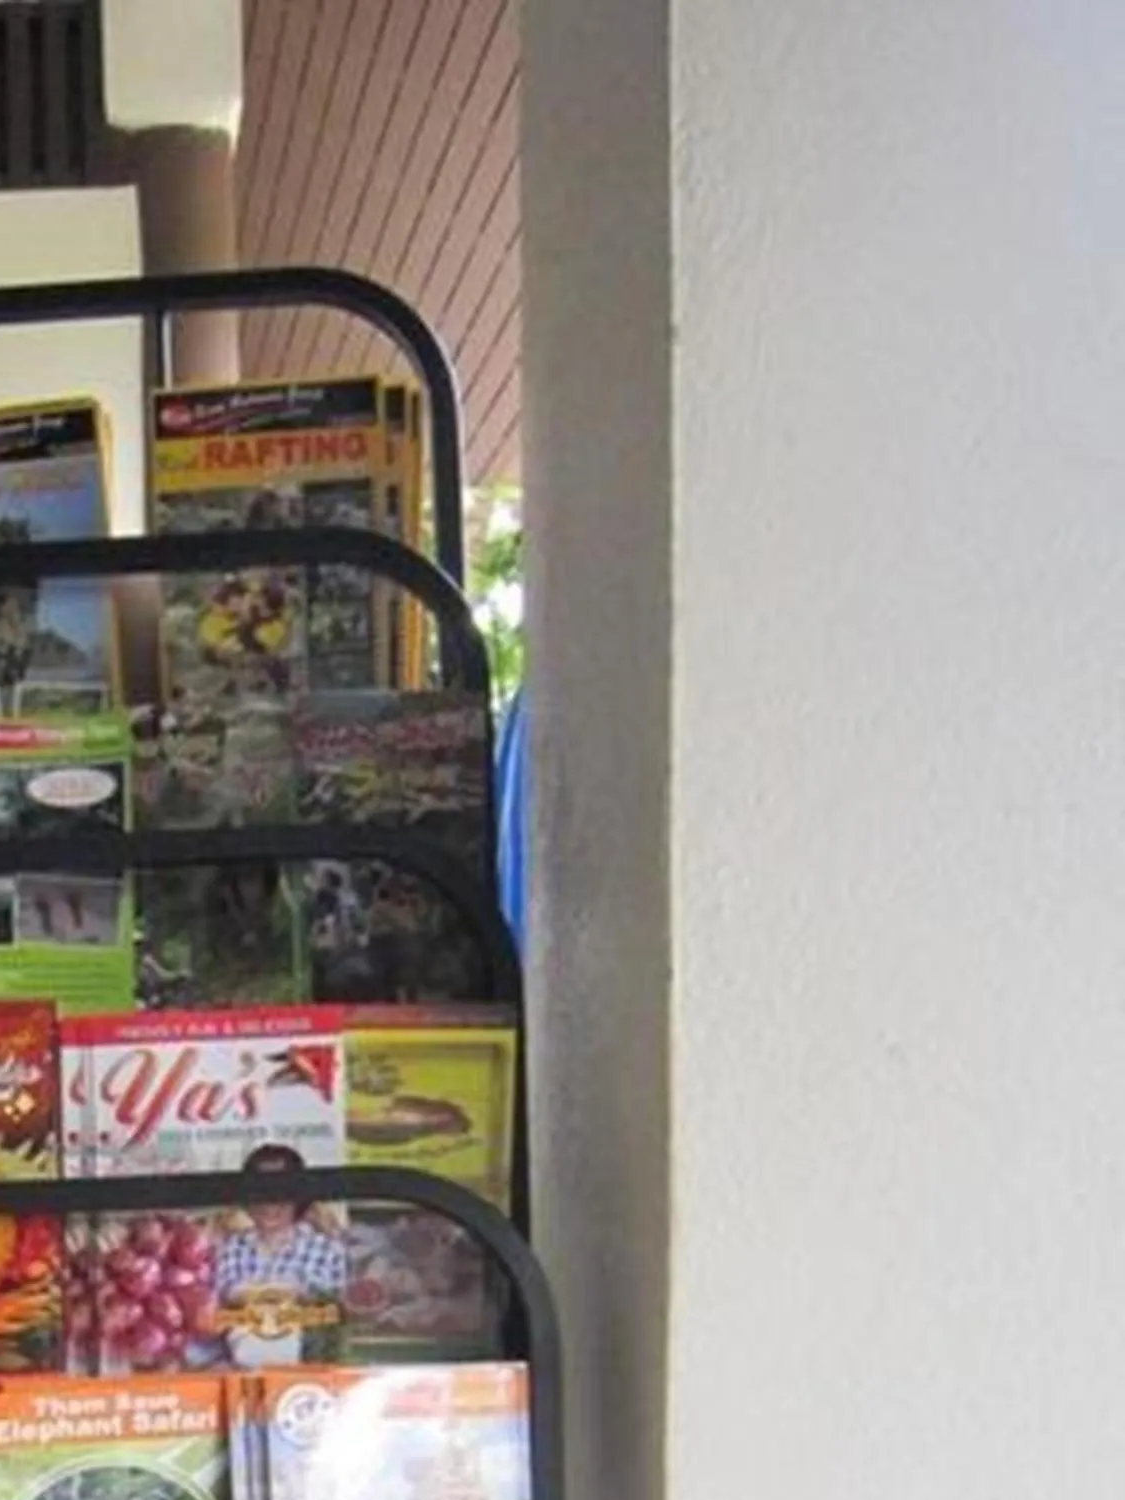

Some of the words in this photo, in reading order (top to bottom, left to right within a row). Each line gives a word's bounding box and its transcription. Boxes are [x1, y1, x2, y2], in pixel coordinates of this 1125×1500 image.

[203, 432, 369, 471] RAFTING
[100, 1047, 259, 1151] Ya's
[132, 1404, 218, 1434] Safari
